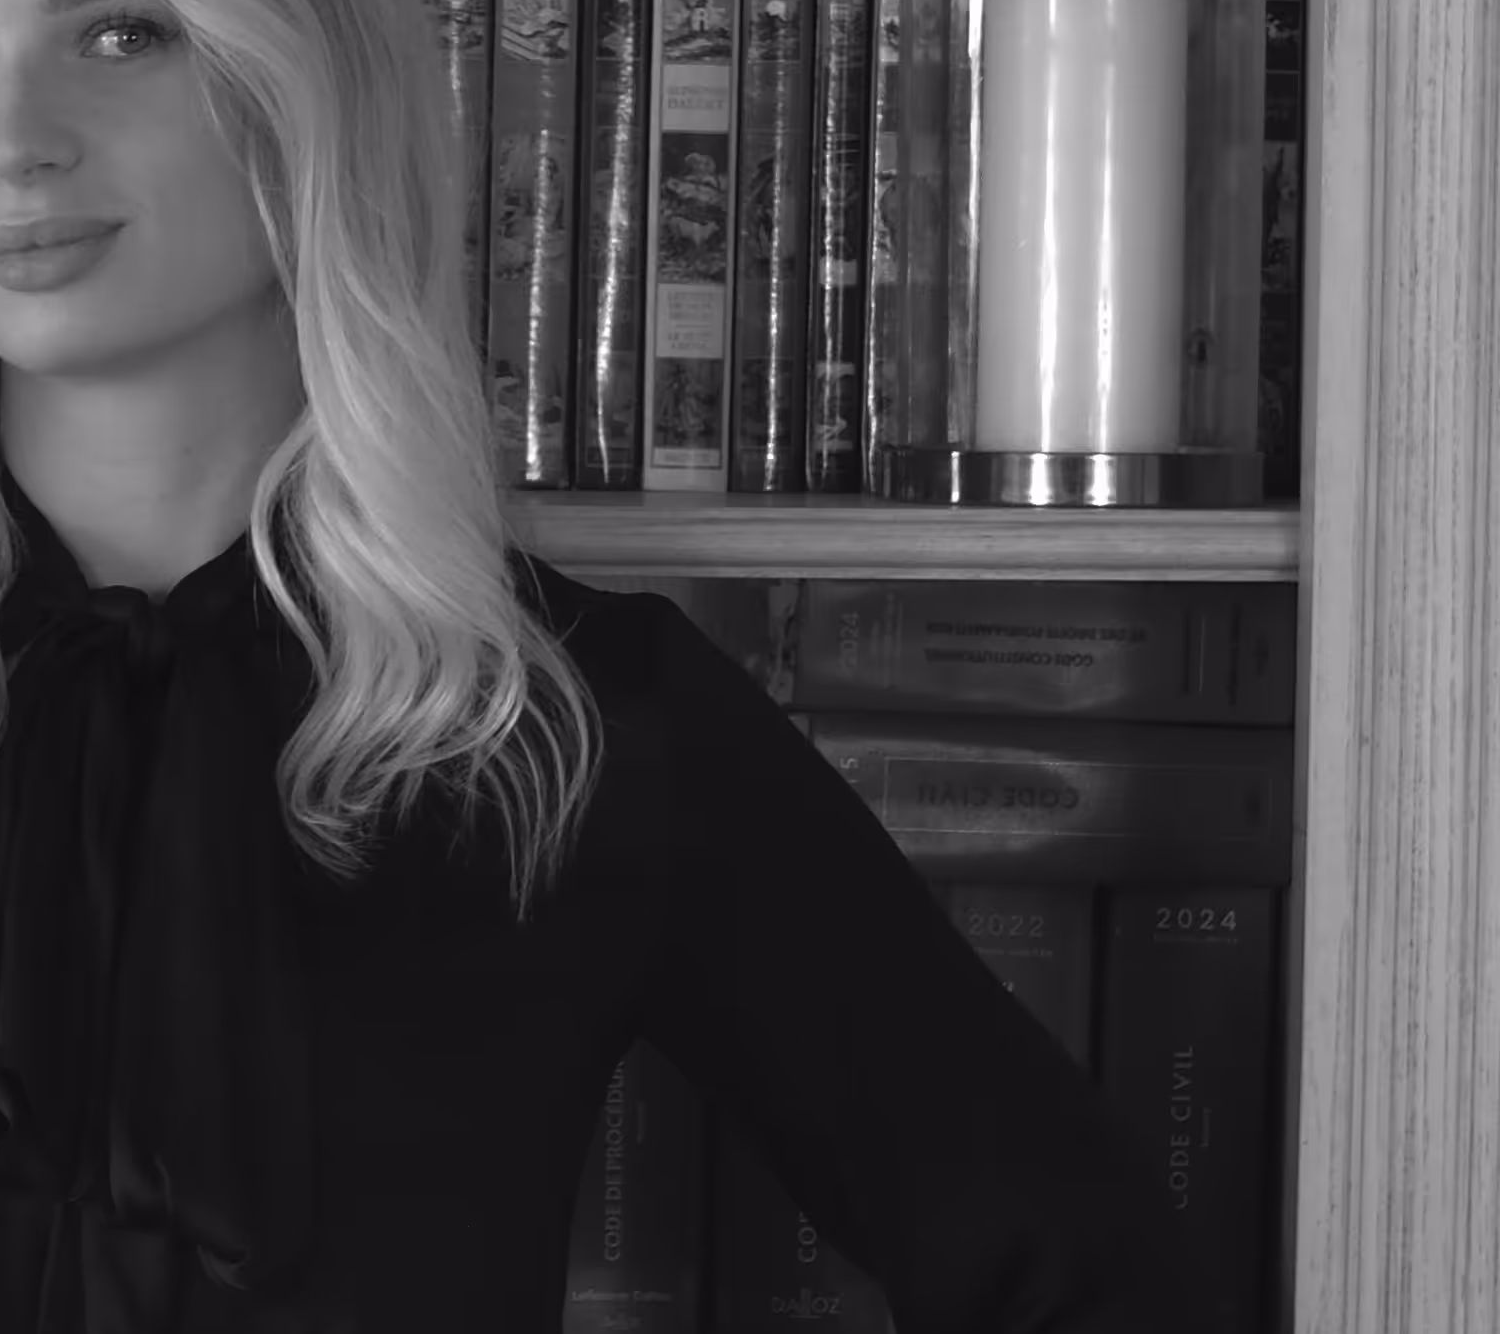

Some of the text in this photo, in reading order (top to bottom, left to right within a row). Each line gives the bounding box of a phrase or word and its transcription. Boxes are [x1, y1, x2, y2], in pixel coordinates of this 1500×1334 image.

[1002, 784, 1080, 809] CODE
[968, 913, 1045, 938] 2022
[1156, 907, 1238, 931] 2024
[1168, 1046, 1193, 1123] CIVIL
[604, 1204, 622, 1262] CODE
